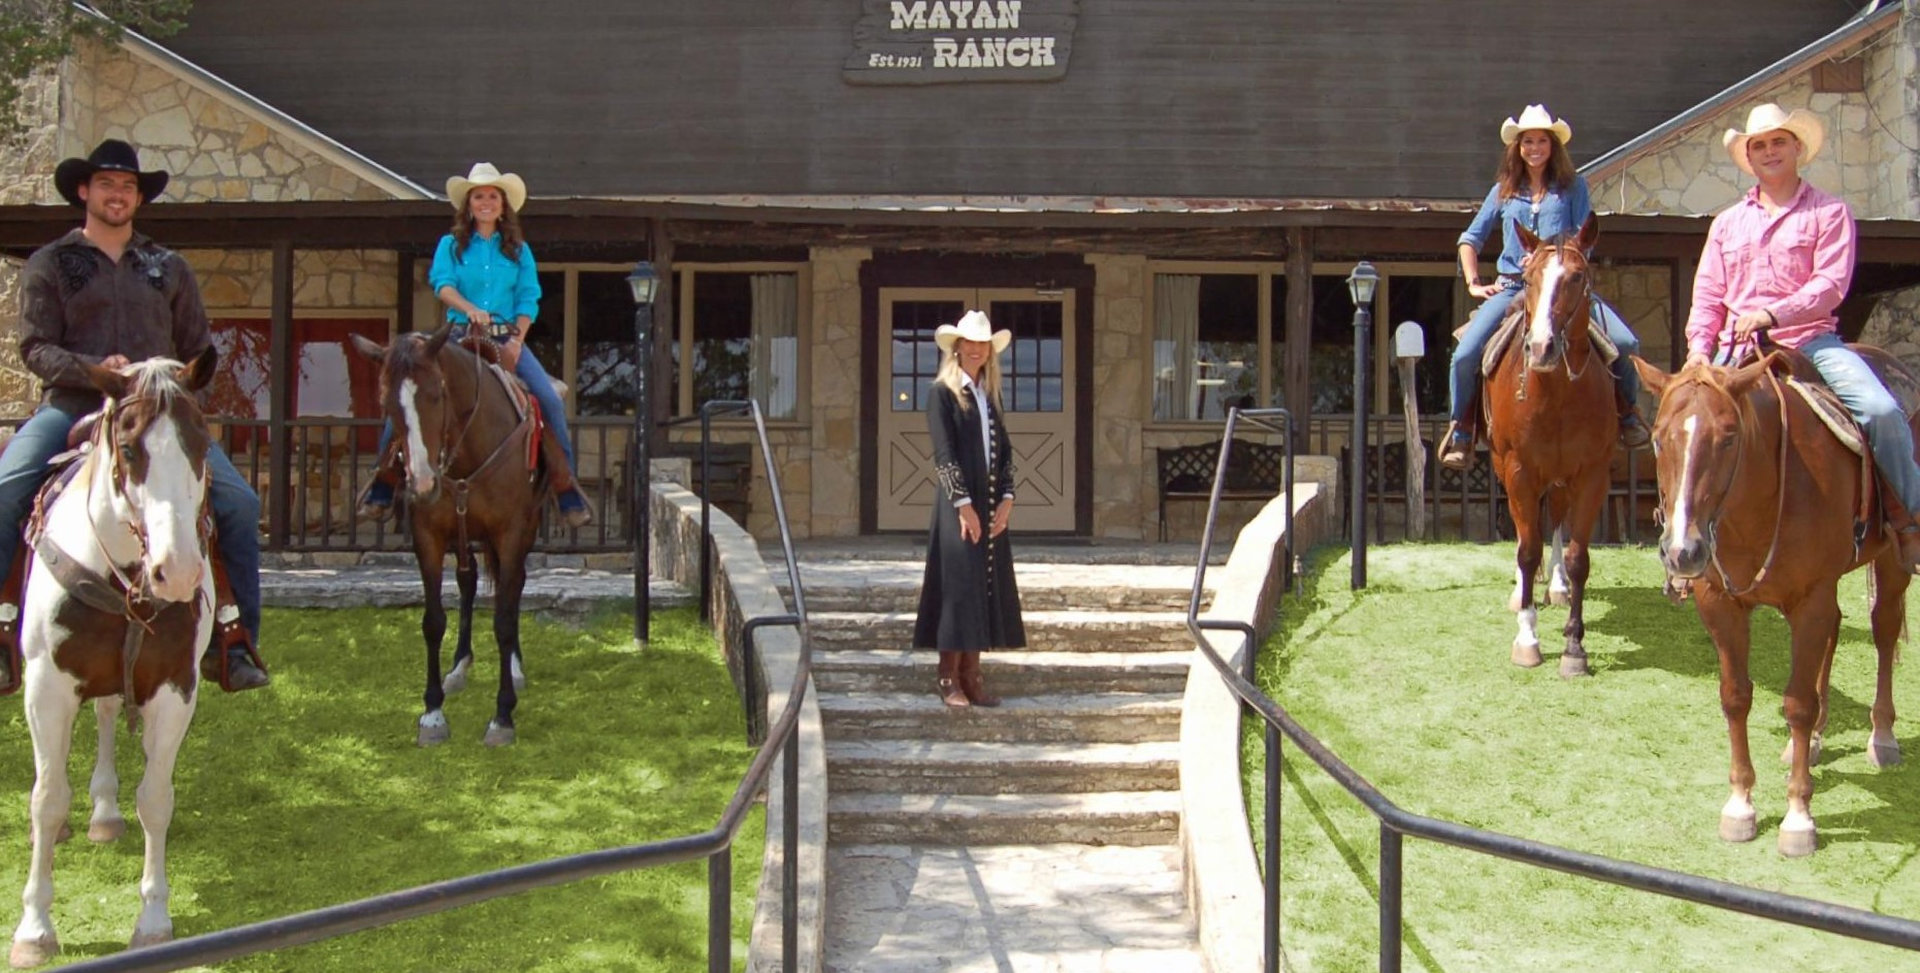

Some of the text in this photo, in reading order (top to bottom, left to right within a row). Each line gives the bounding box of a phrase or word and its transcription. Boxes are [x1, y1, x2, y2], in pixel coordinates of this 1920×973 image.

[890, 0, 1021, 29] MAYAN
[896, 56, 922, 68] 1931
[933, 37, 1056, 67] RANCH
